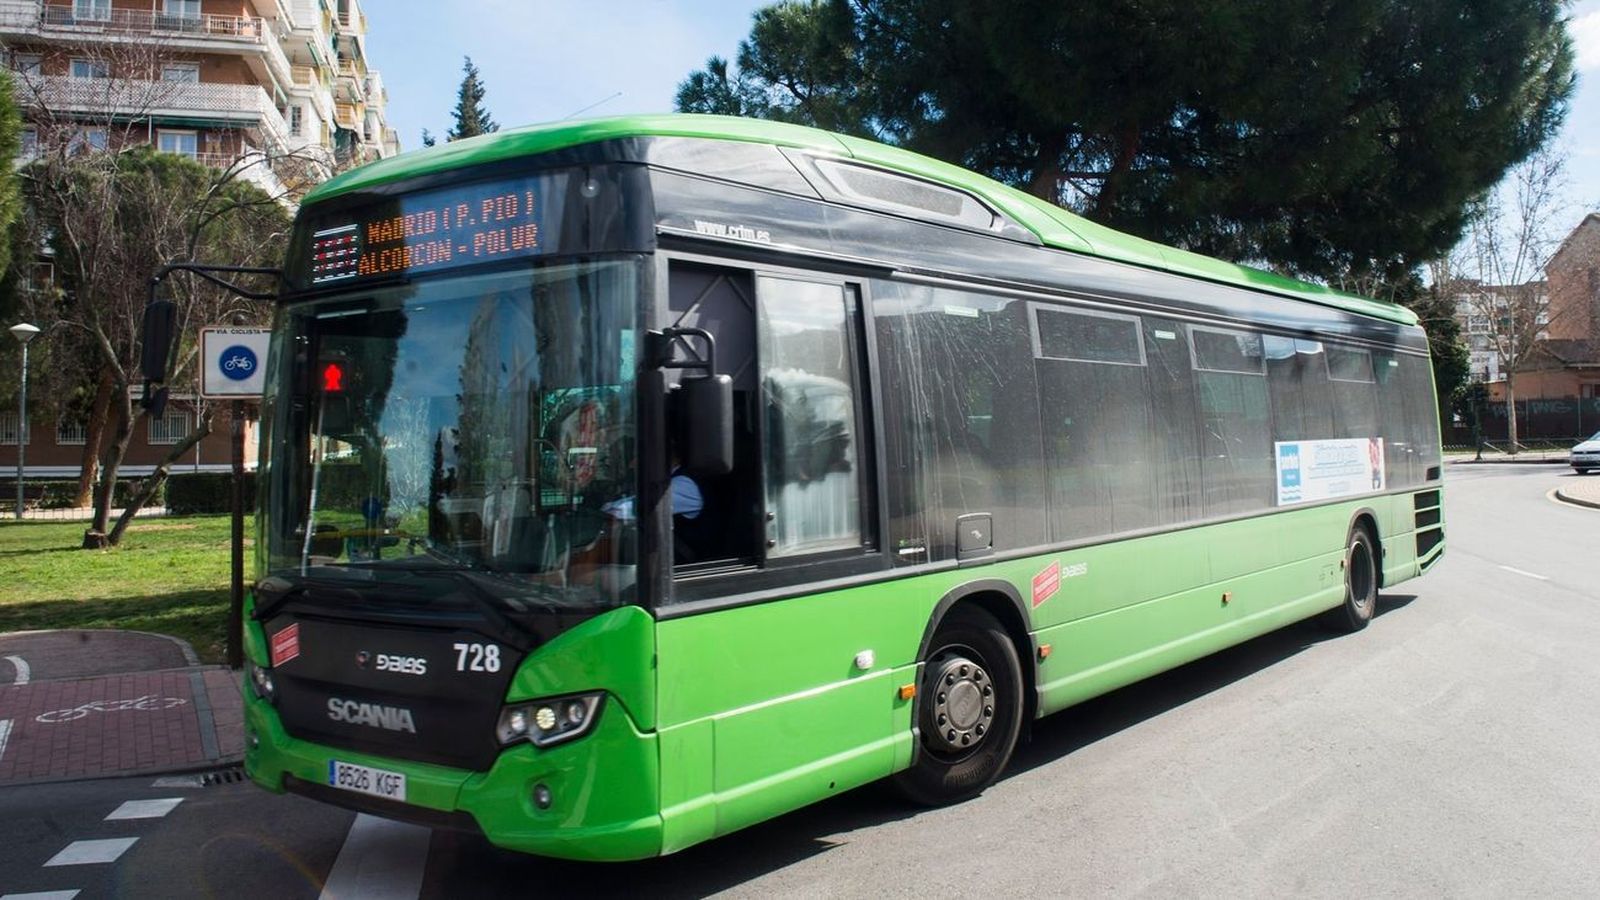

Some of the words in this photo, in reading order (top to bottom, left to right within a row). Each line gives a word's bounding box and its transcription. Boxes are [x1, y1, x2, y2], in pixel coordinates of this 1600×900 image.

[368, 210, 436, 244] MADRID
[358, 238, 451, 276] ALCORCON
[453, 643, 501, 674] 728
[327, 698, 416, 733] SCANIA
[339, 765, 370, 790] 8526
[375, 772, 402, 796] KGF
